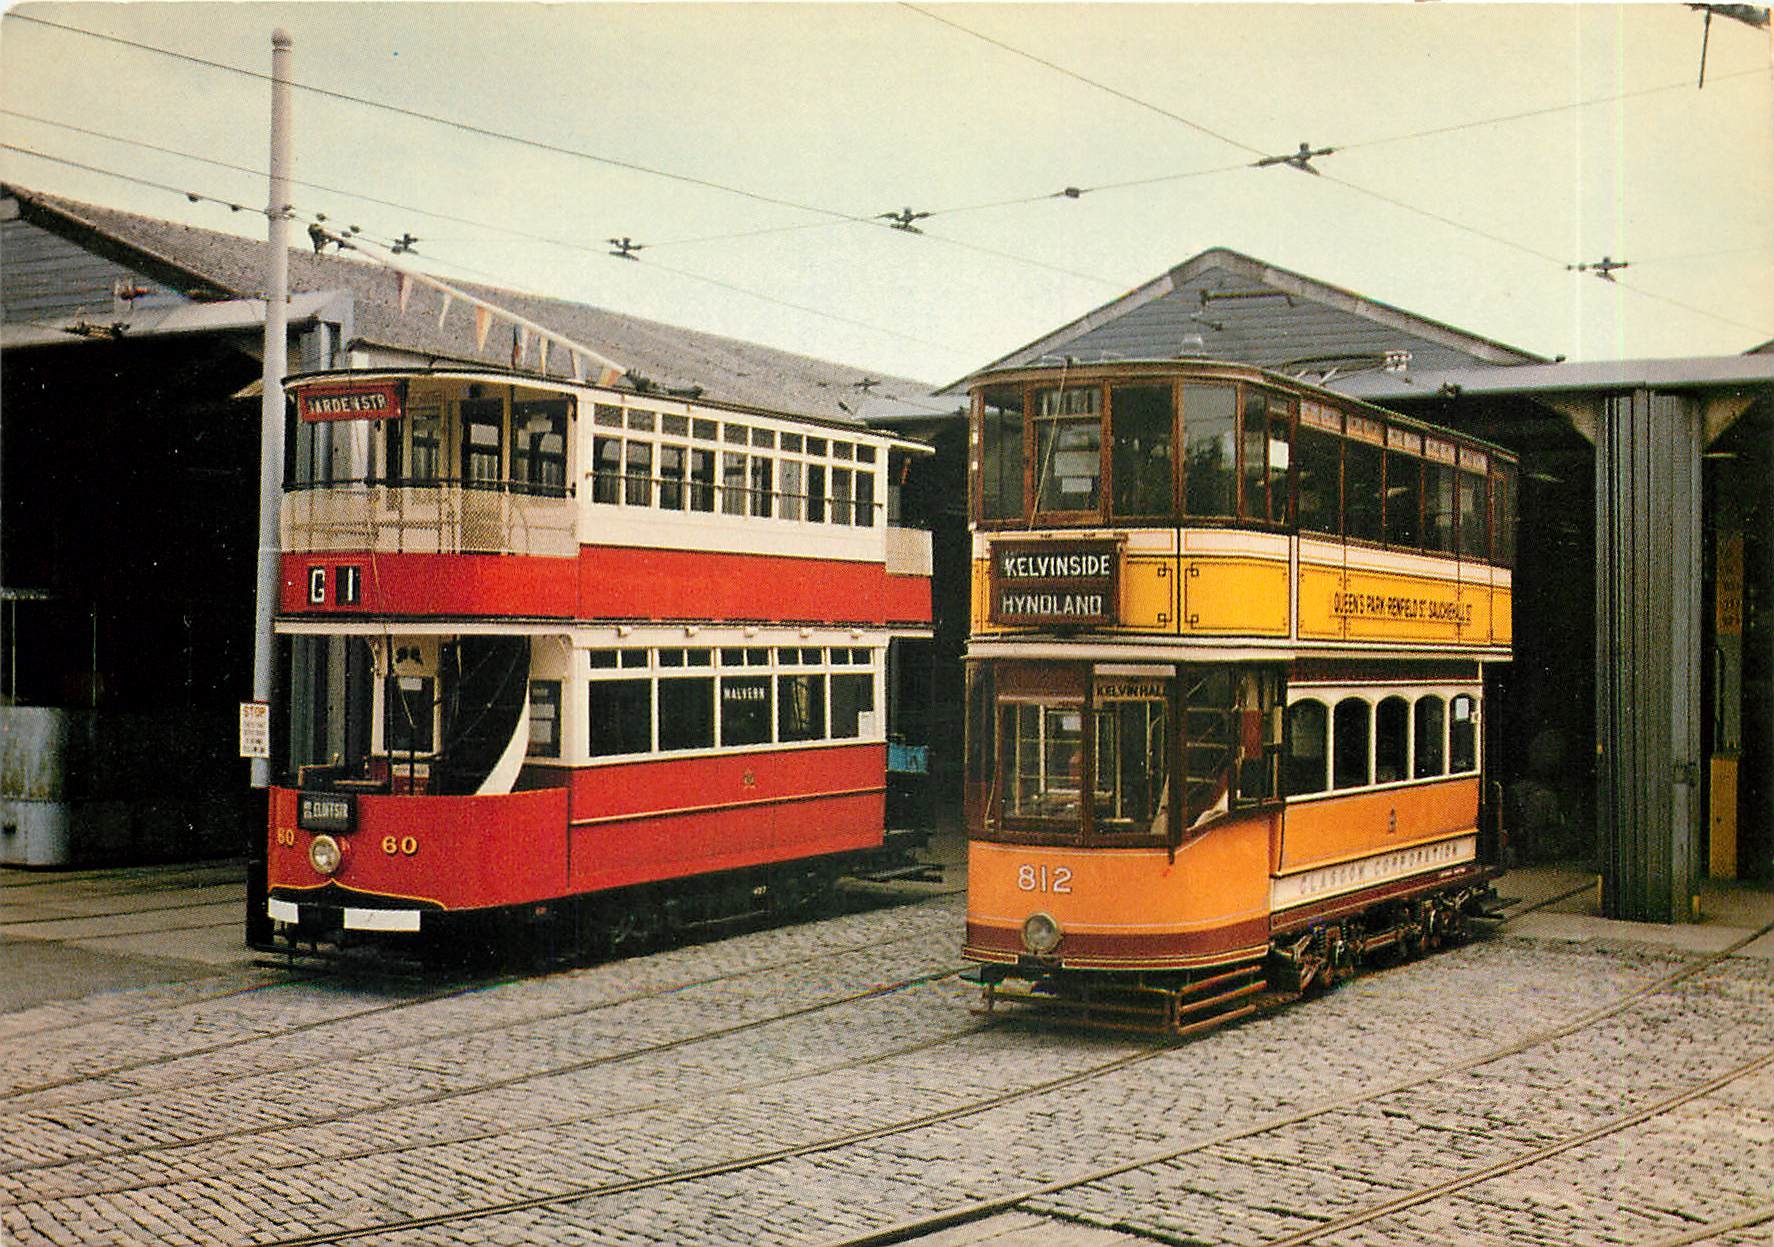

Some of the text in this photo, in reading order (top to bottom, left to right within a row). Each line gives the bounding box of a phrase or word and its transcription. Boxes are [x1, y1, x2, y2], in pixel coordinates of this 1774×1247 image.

[1004, 555, 1111, 578] KELVINSIDE
[311, 568, 326, 603] G
[1002, 594, 1103, 616] HYNDLAND
[1367, 595, 1385, 615] PARK
[723, 687, 765, 700] MALVERN
[277, 828, 295, 846] 60
[382, 836, 419, 856] 60
[1017, 864, 1073, 894] 812
